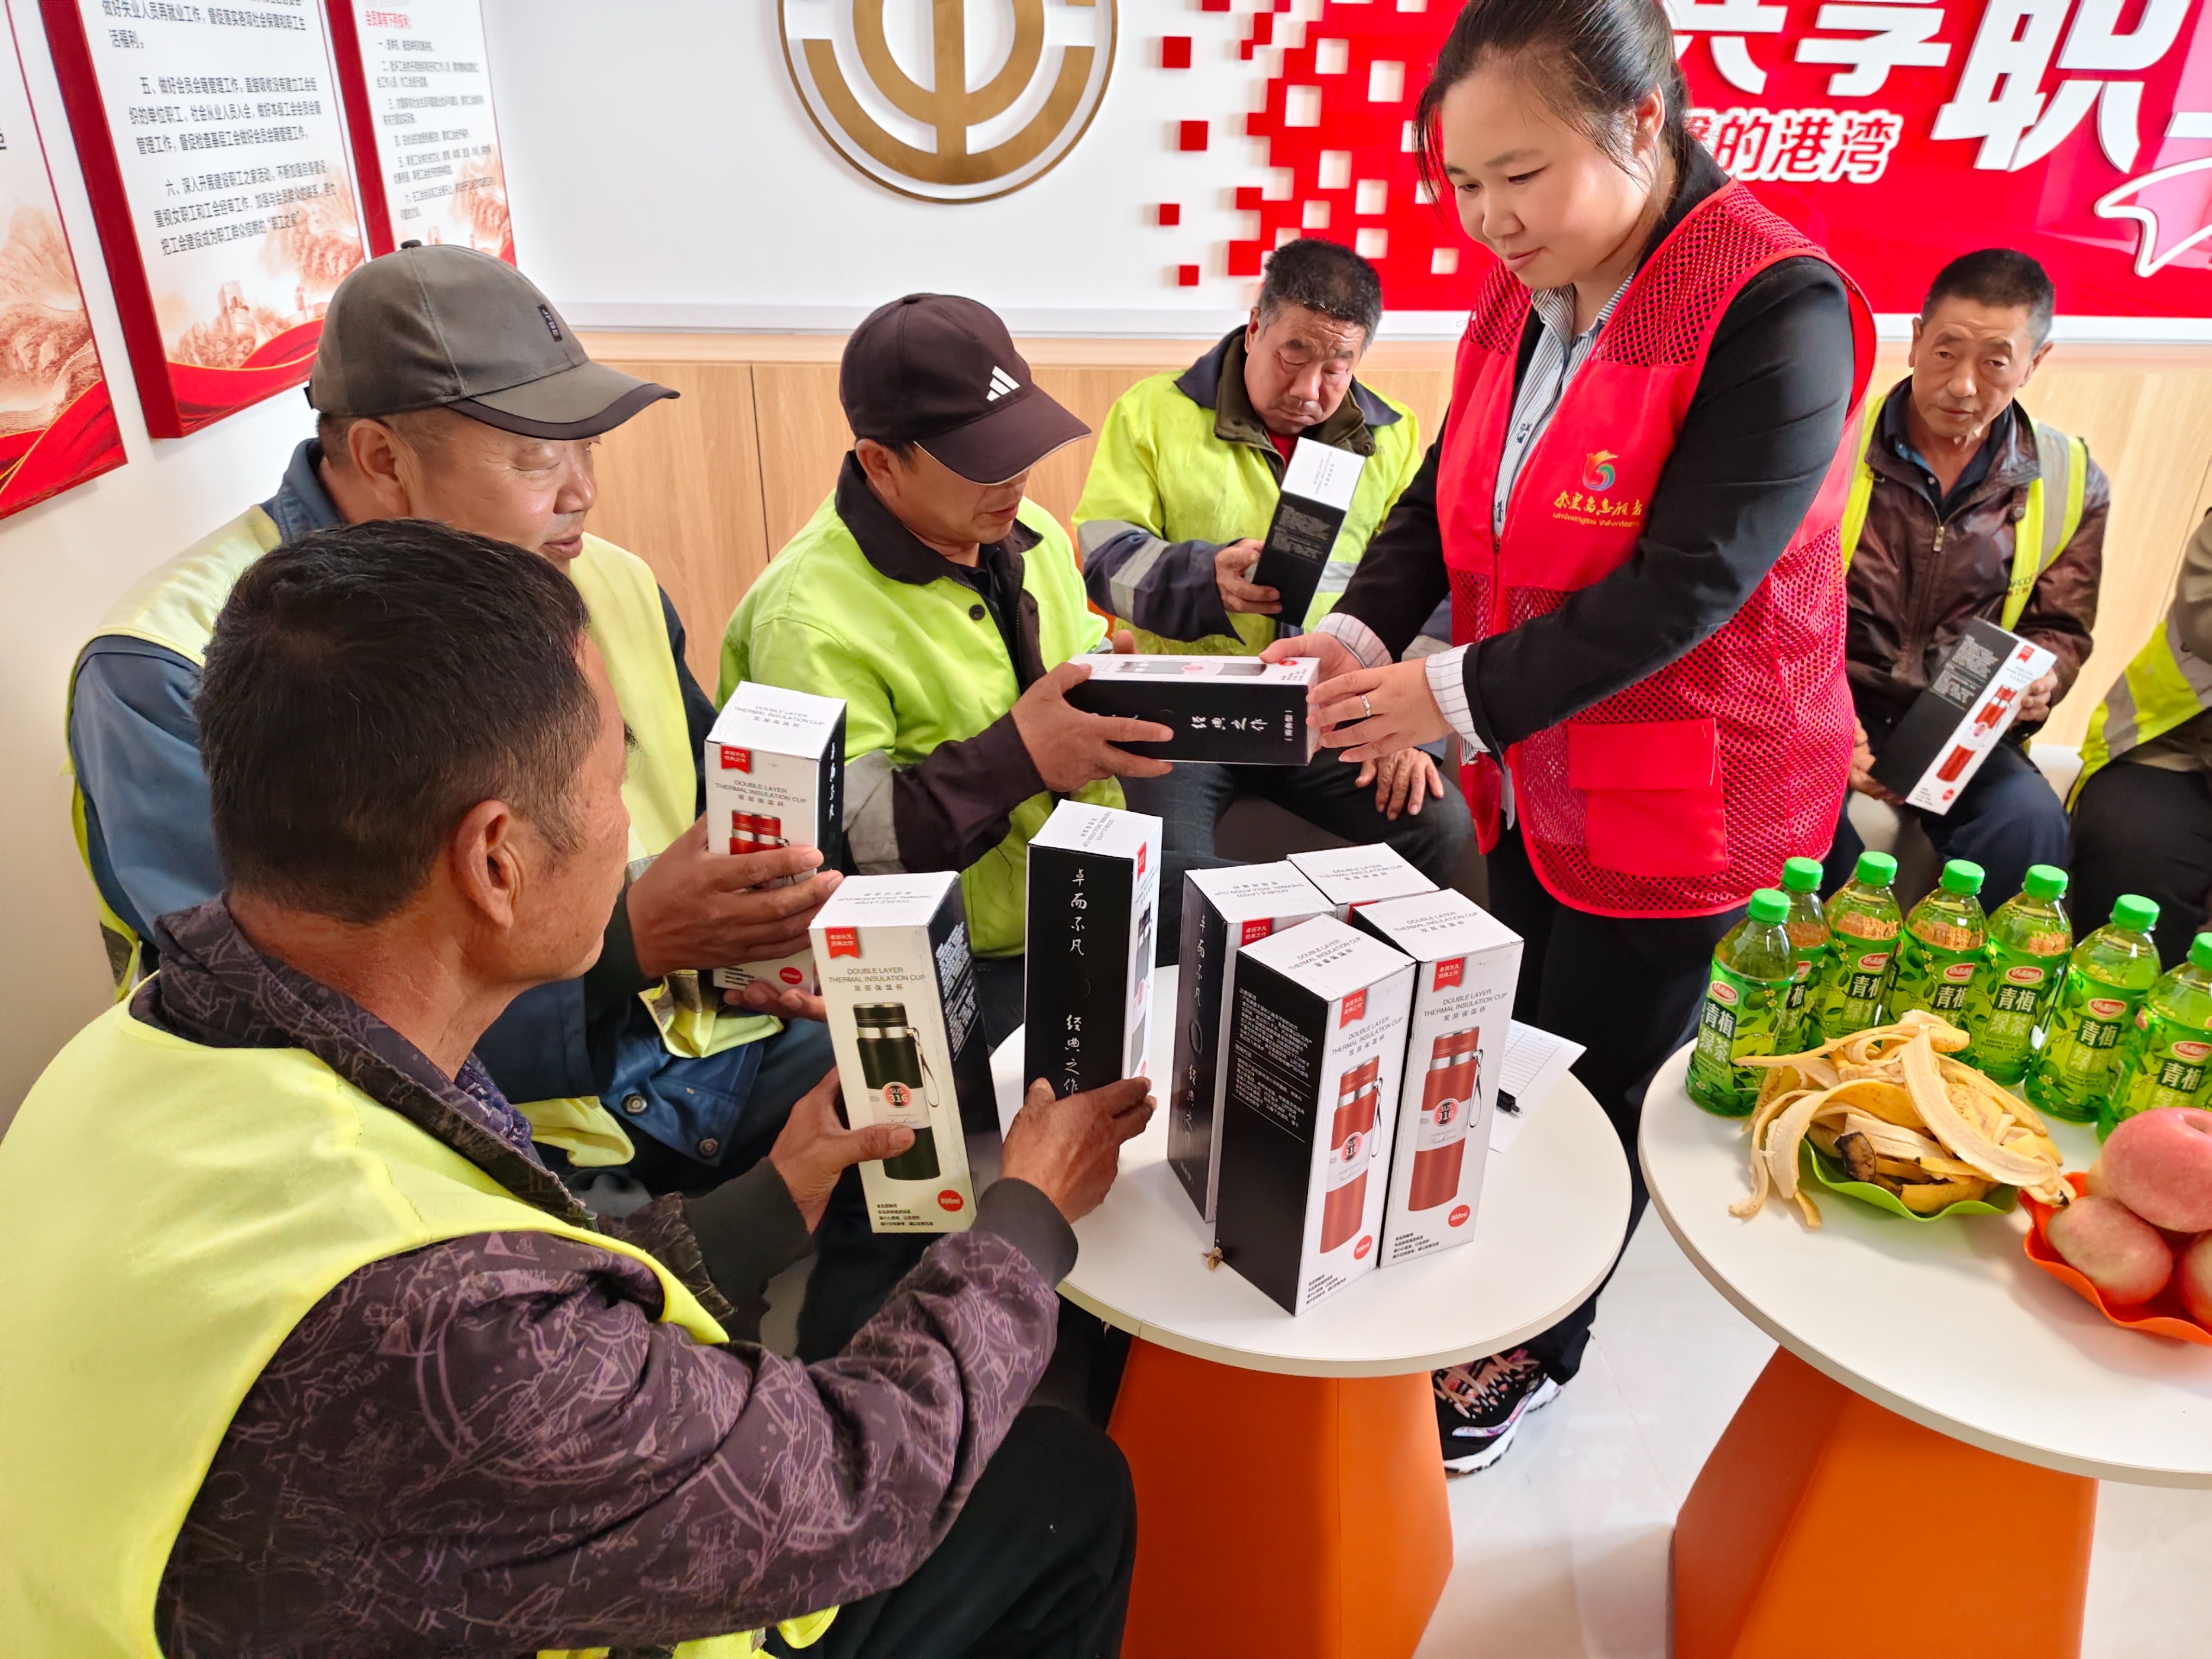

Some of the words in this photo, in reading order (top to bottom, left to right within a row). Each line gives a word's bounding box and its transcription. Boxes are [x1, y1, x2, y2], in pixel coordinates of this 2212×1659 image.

[1685, 112, 1900, 177] 的港湾
[715, 783, 748, 793] THERMAL
[750, 789, 791, 801] INSULATION
[734, 780, 763, 790] DOUBLE
[764, 785, 787, 793] LAYER
[1069, 867, 1088, 957] 卓而不凡
[1393, 923, 1426, 932] THERMAL
[1426, 914, 1465, 925] INSULATION
[1407, 916, 1433, 924] DOUBLE
[1435, 911, 1457, 919] LAYER
[1287, 957, 1317, 970] THERMAL
[1315, 942, 1350, 958] INSULATION
[1297, 948, 1322, 960] DOUBLE
[1321, 939, 1341, 950] LAYER
[1424, 1007, 1454, 1017] THERMAL
[1455, 996, 1494, 1010] INSULATION
[1494, 992, 1508, 1000] CUP
[1443, 994, 1470, 1005] DOUBLE
[1471, 989, 1491, 999] LAYER
[1997, 987, 2037, 1013] 青梅
[1444, 1006, 1486, 1021] 双层保温杯
[1705, 1002, 1734, 1038] 青梅
[1990, 1011, 2027, 1037] 绿茶
[1332, 1040, 1358, 1056] THERMAL
[1359, 1023, 1391, 1042] INSULATION
[1391, 1016, 1403, 1027] CUP
[1348, 1024, 1371, 1040] DOUBLE
[1372, 1016, 1390, 1029] LAYER
[2080, 1020, 2119, 1047] 青梅
[1063, 1014, 1083, 1095] 经典之作
[1349, 1034, 1385, 1056] 双层保温杯
[1698, 1027, 1729, 1063] 绿茶
[2161, 1062, 2203, 1090] 青梅
[889, 1094, 908, 1103] 316
[1441, 1104, 1453, 1112] SUS
[1436, 1110, 1454, 1122] 316
[1344, 1144, 1359, 1158] 316
[1347, 1138, 1357, 1148] SUS
[1451, 1210, 1468, 1222] 800ml
